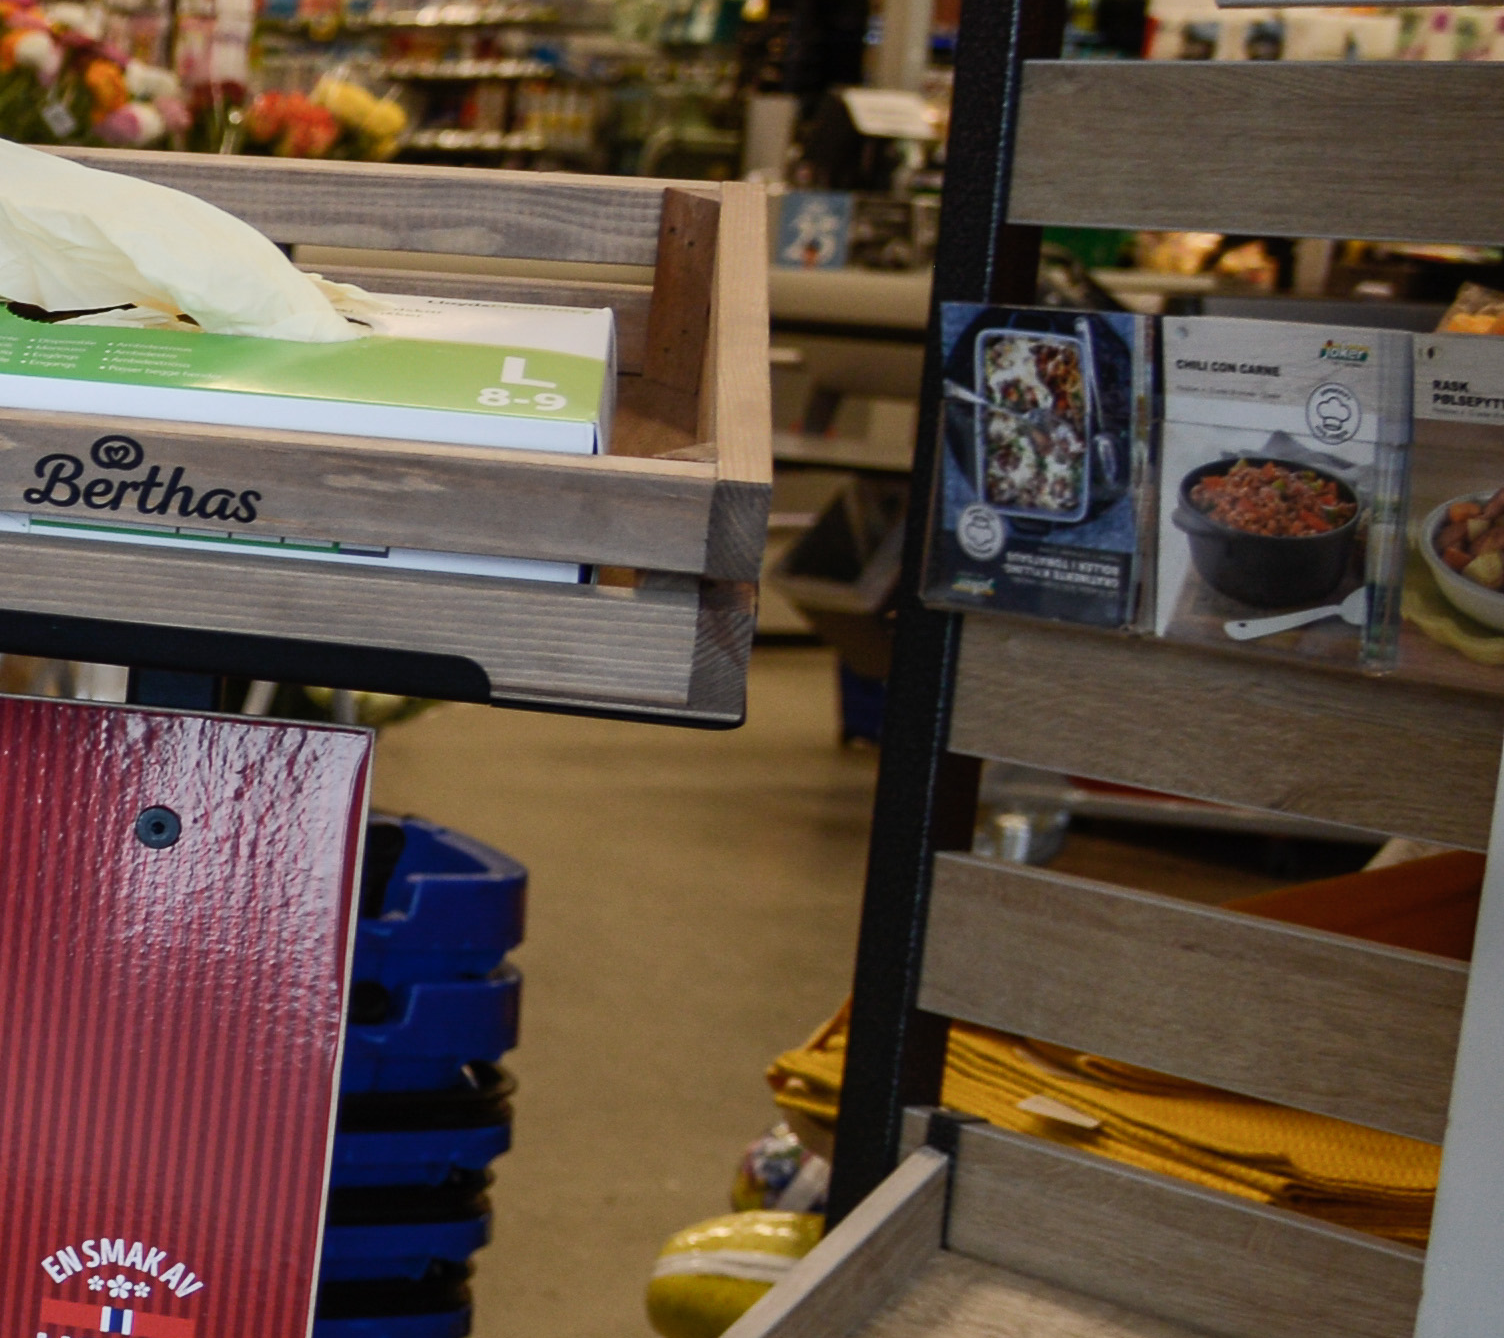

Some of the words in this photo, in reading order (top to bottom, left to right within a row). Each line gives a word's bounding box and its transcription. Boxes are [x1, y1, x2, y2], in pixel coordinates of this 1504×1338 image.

[500, 356, 558, 389] L
[1176, 359, 1208, 372] CHILI
[1211, 361, 1237, 374] CON
[1239, 363, 1281, 377] CARNE
[477, 387, 568, 411] 8-9
[1432, 380, 1469, 394] RASK
[23, 452, 263, 524] Berthas
[40, 1244, 83, 1285] EN
[81, 1237, 165, 1278] SMAK
[157, 1260, 204, 1300] AV
